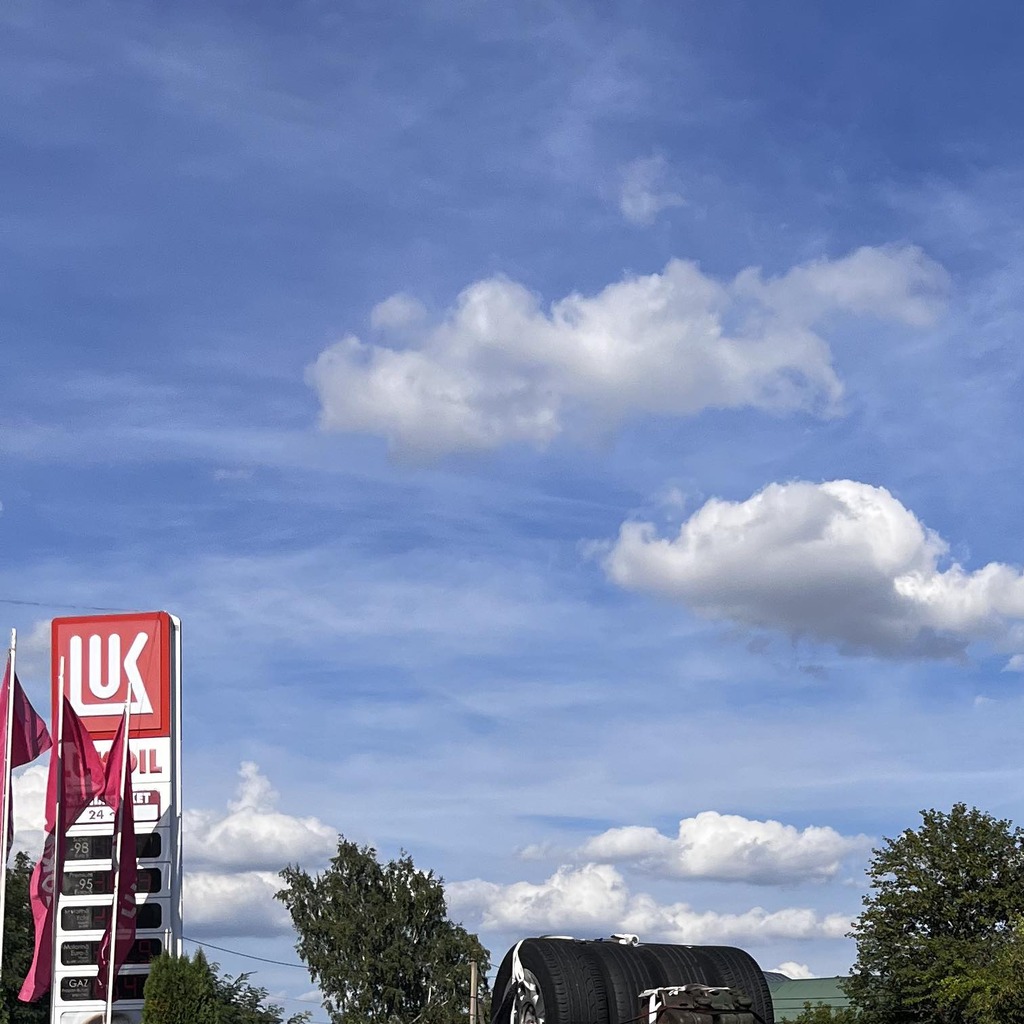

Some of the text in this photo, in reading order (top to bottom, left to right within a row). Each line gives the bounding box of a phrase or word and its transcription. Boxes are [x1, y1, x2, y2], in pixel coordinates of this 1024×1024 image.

[70, 632, 153, 717] LUK
[89, 809, 105, 820] 24
[68, 978, 89, 988] GAZ
